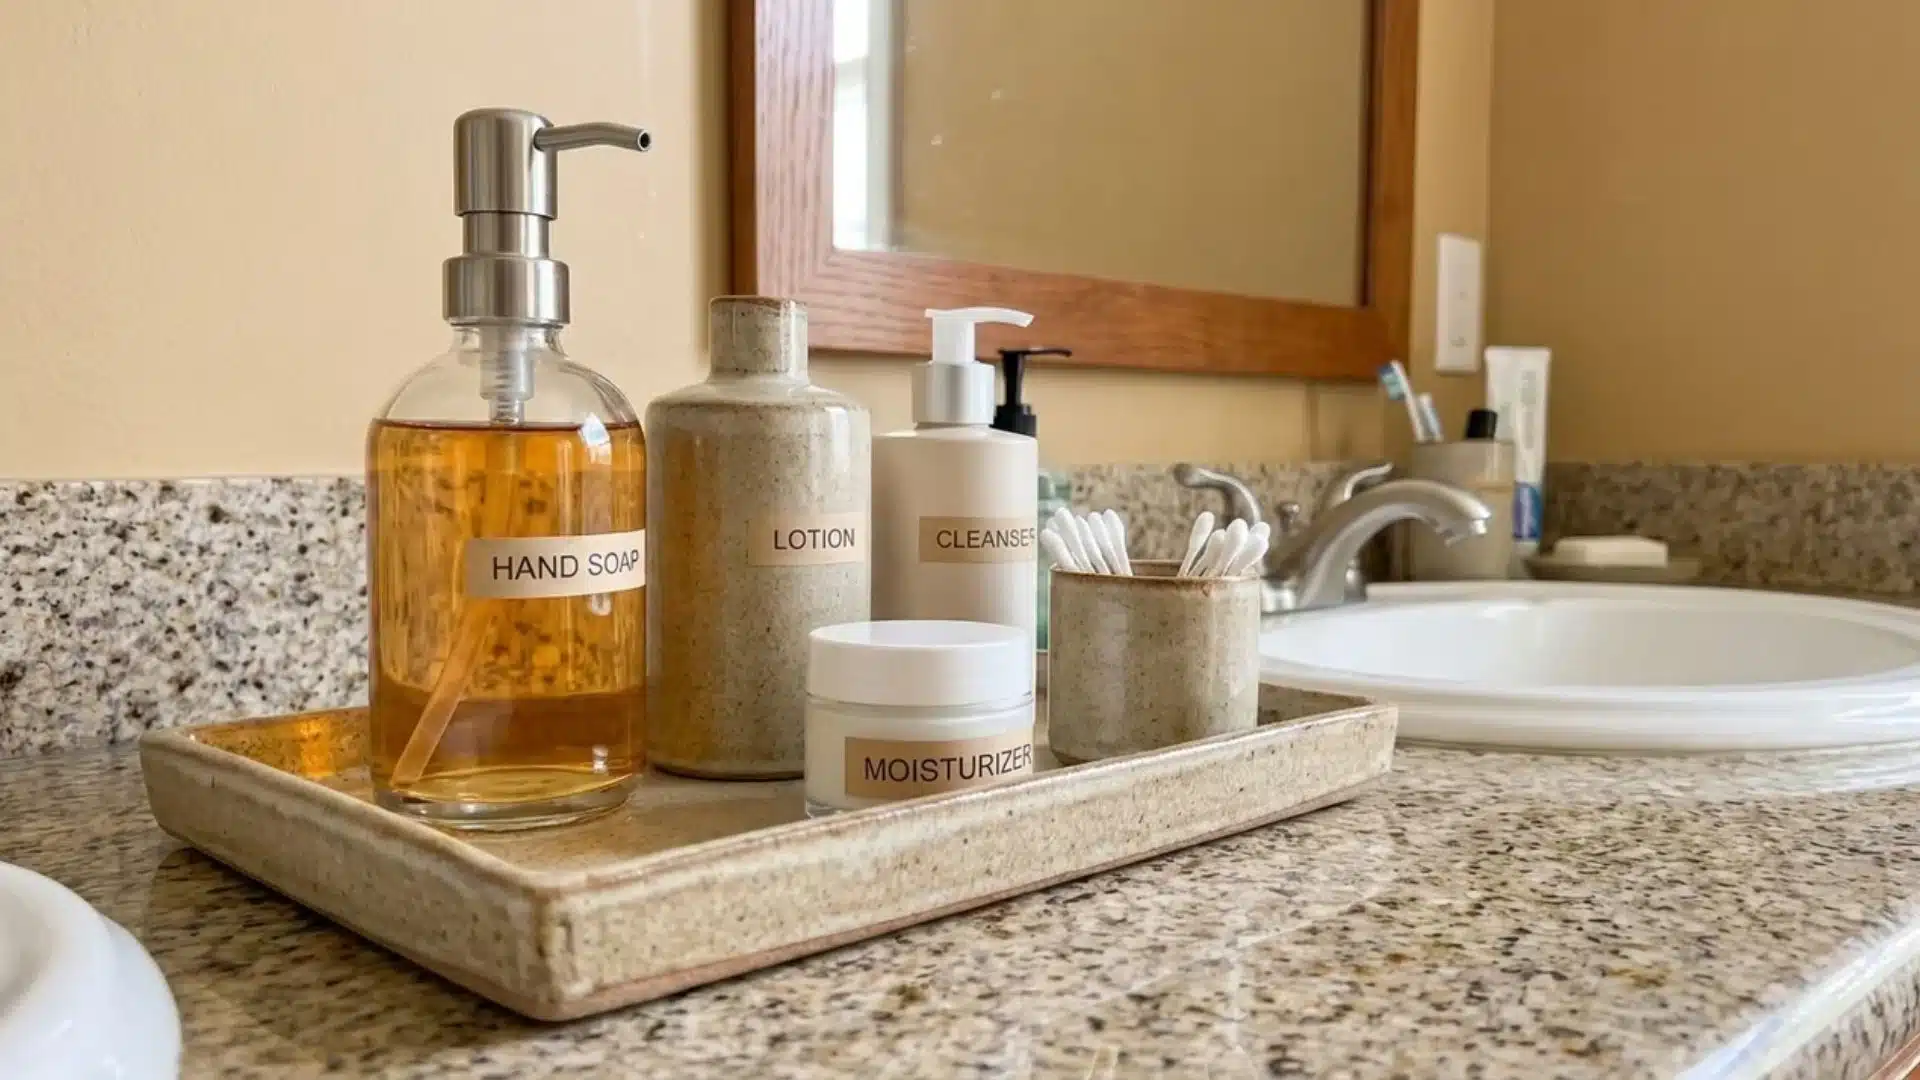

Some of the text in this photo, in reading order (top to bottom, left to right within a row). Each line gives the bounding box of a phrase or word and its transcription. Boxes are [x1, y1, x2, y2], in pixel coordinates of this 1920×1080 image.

[773, 528, 856, 550] LOTION
[493, 549, 639, 580] HAND SOAP
[864, 743, 1032, 783] MOISTURIZER
